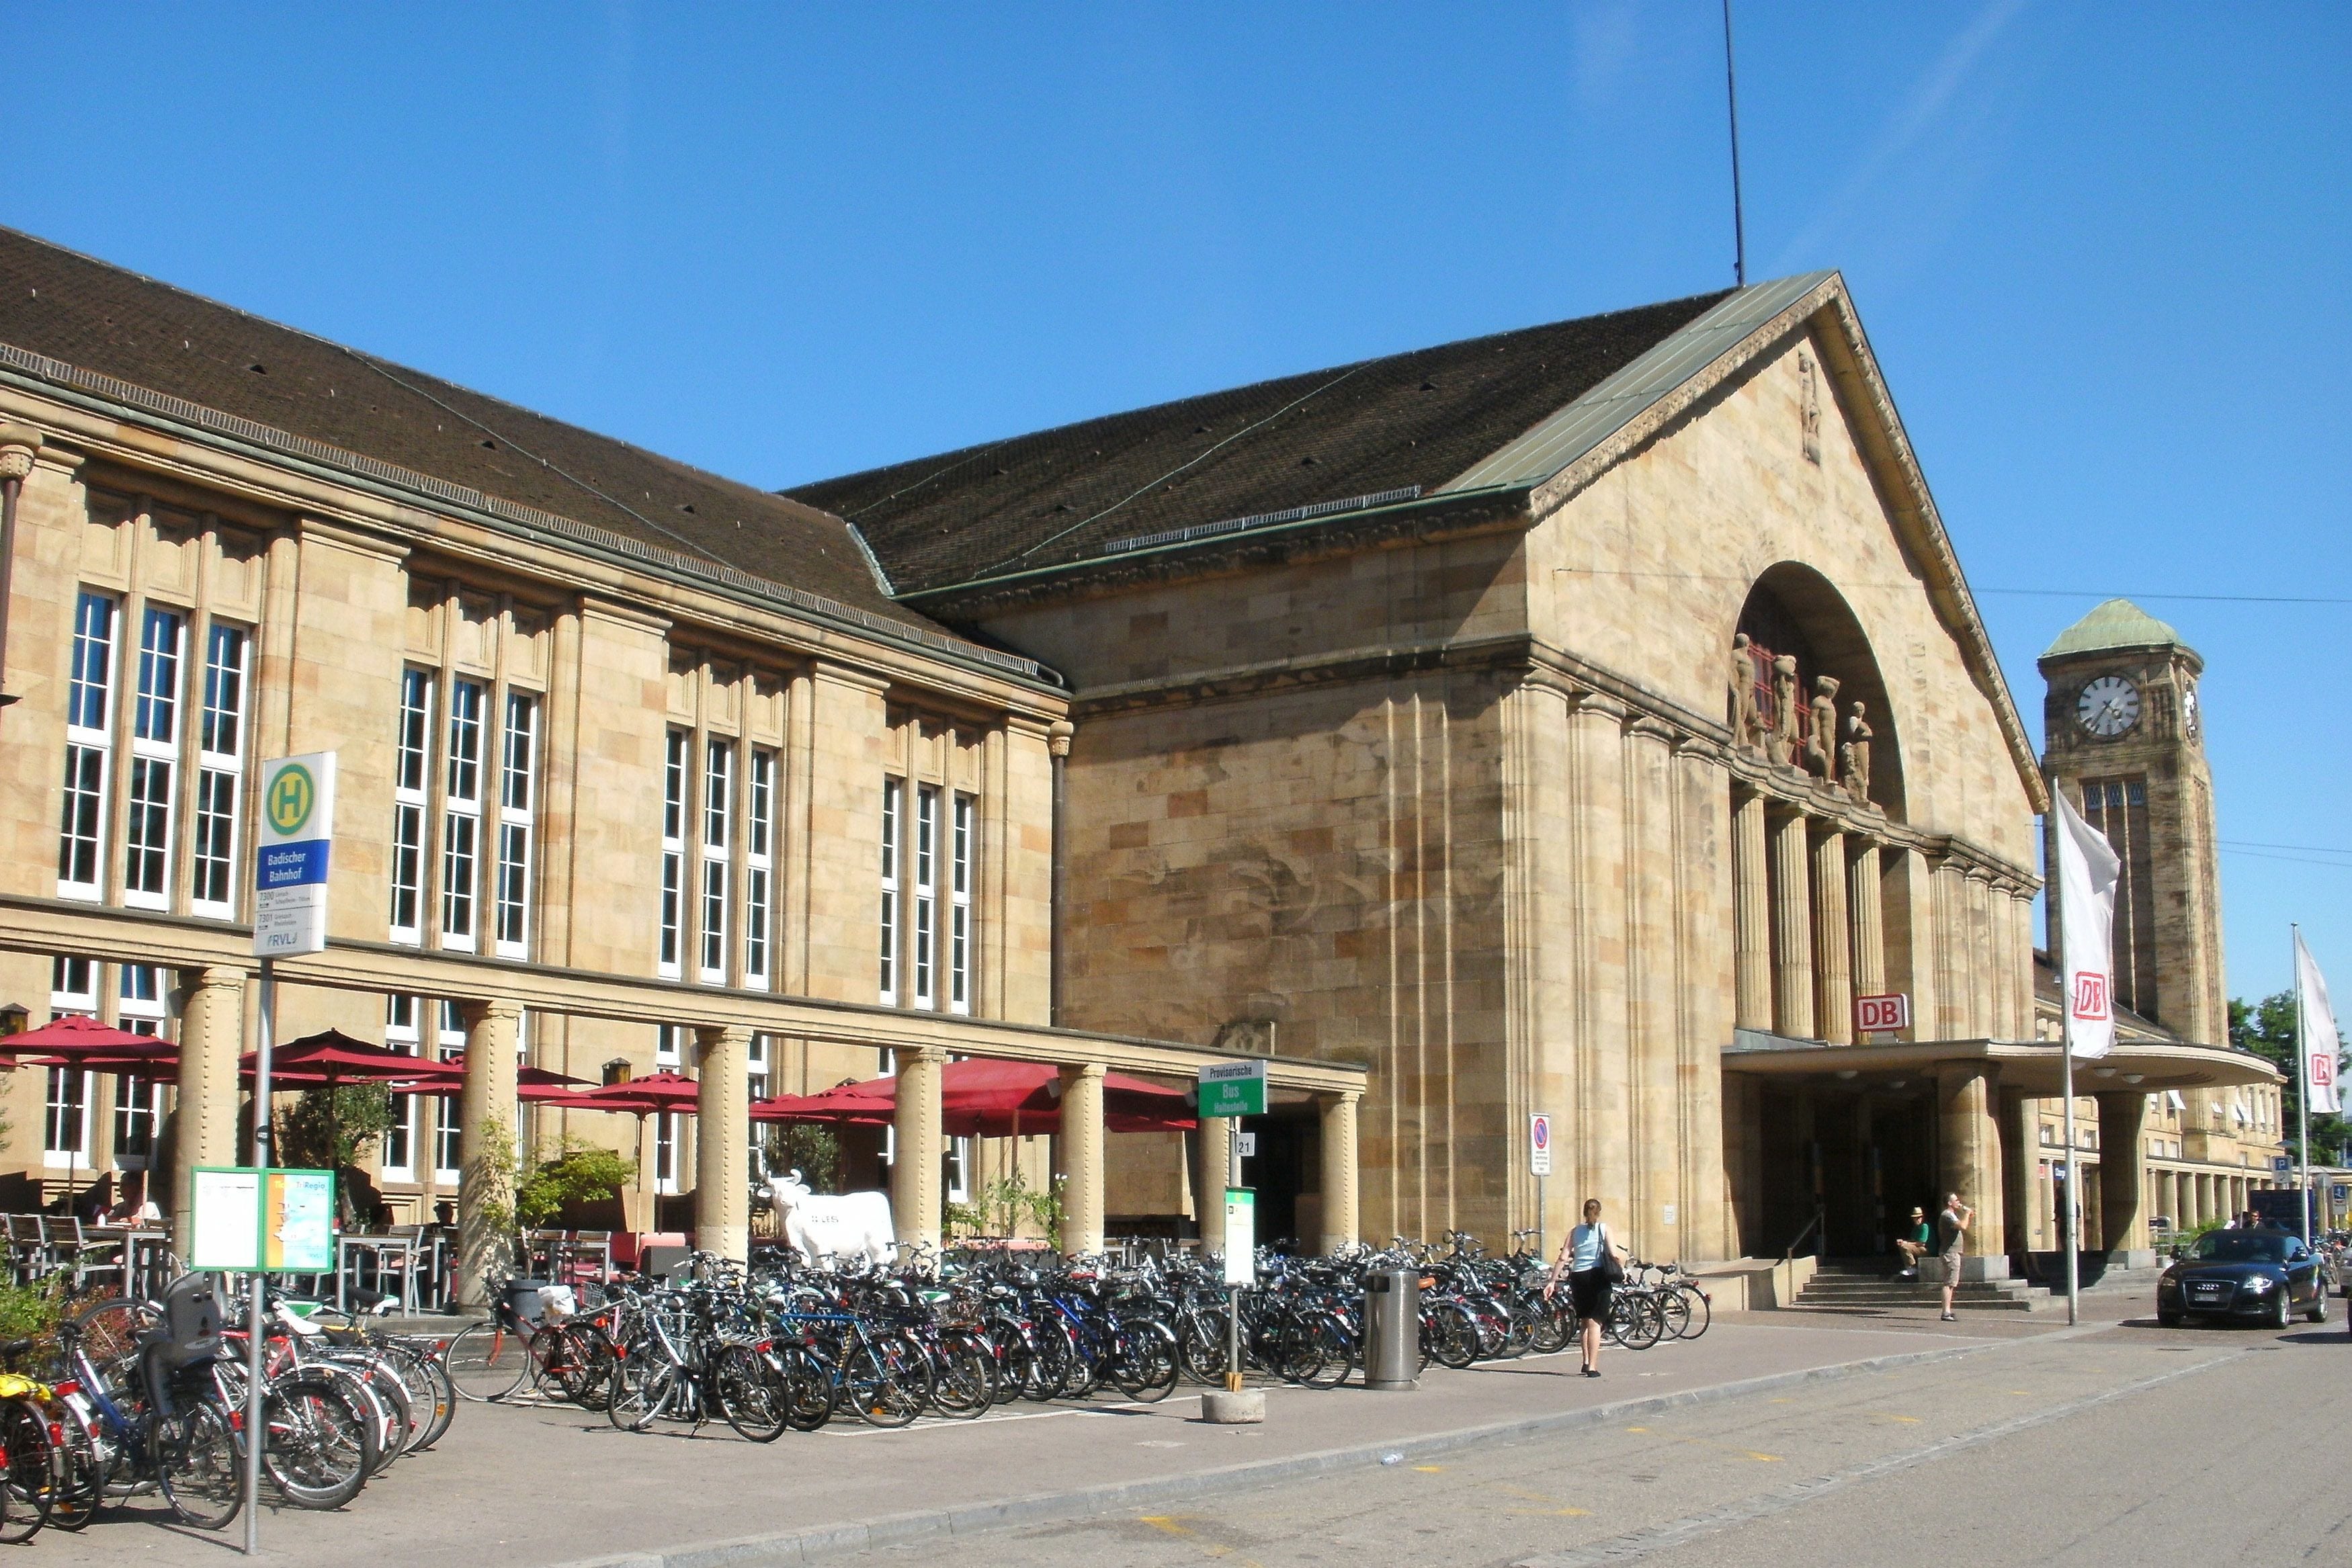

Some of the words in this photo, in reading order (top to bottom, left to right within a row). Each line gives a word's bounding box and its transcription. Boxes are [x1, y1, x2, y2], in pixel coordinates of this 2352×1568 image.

[267, 851, 306, 866] Badischer
[269, 867, 302, 882] Bahnhof
[2080, 979, 2101, 1012] DB
[1862, 1001, 1898, 1026] DB
[1210, 1065, 1253, 1078] Provisorische
[1222, 1084, 1240, 1098] Bus
[1214, 1100, 1249, 1113] Haltestelle
[1238, 1142, 1250, 1153] 21
[296, 1181, 325, 1190] TriRegio
